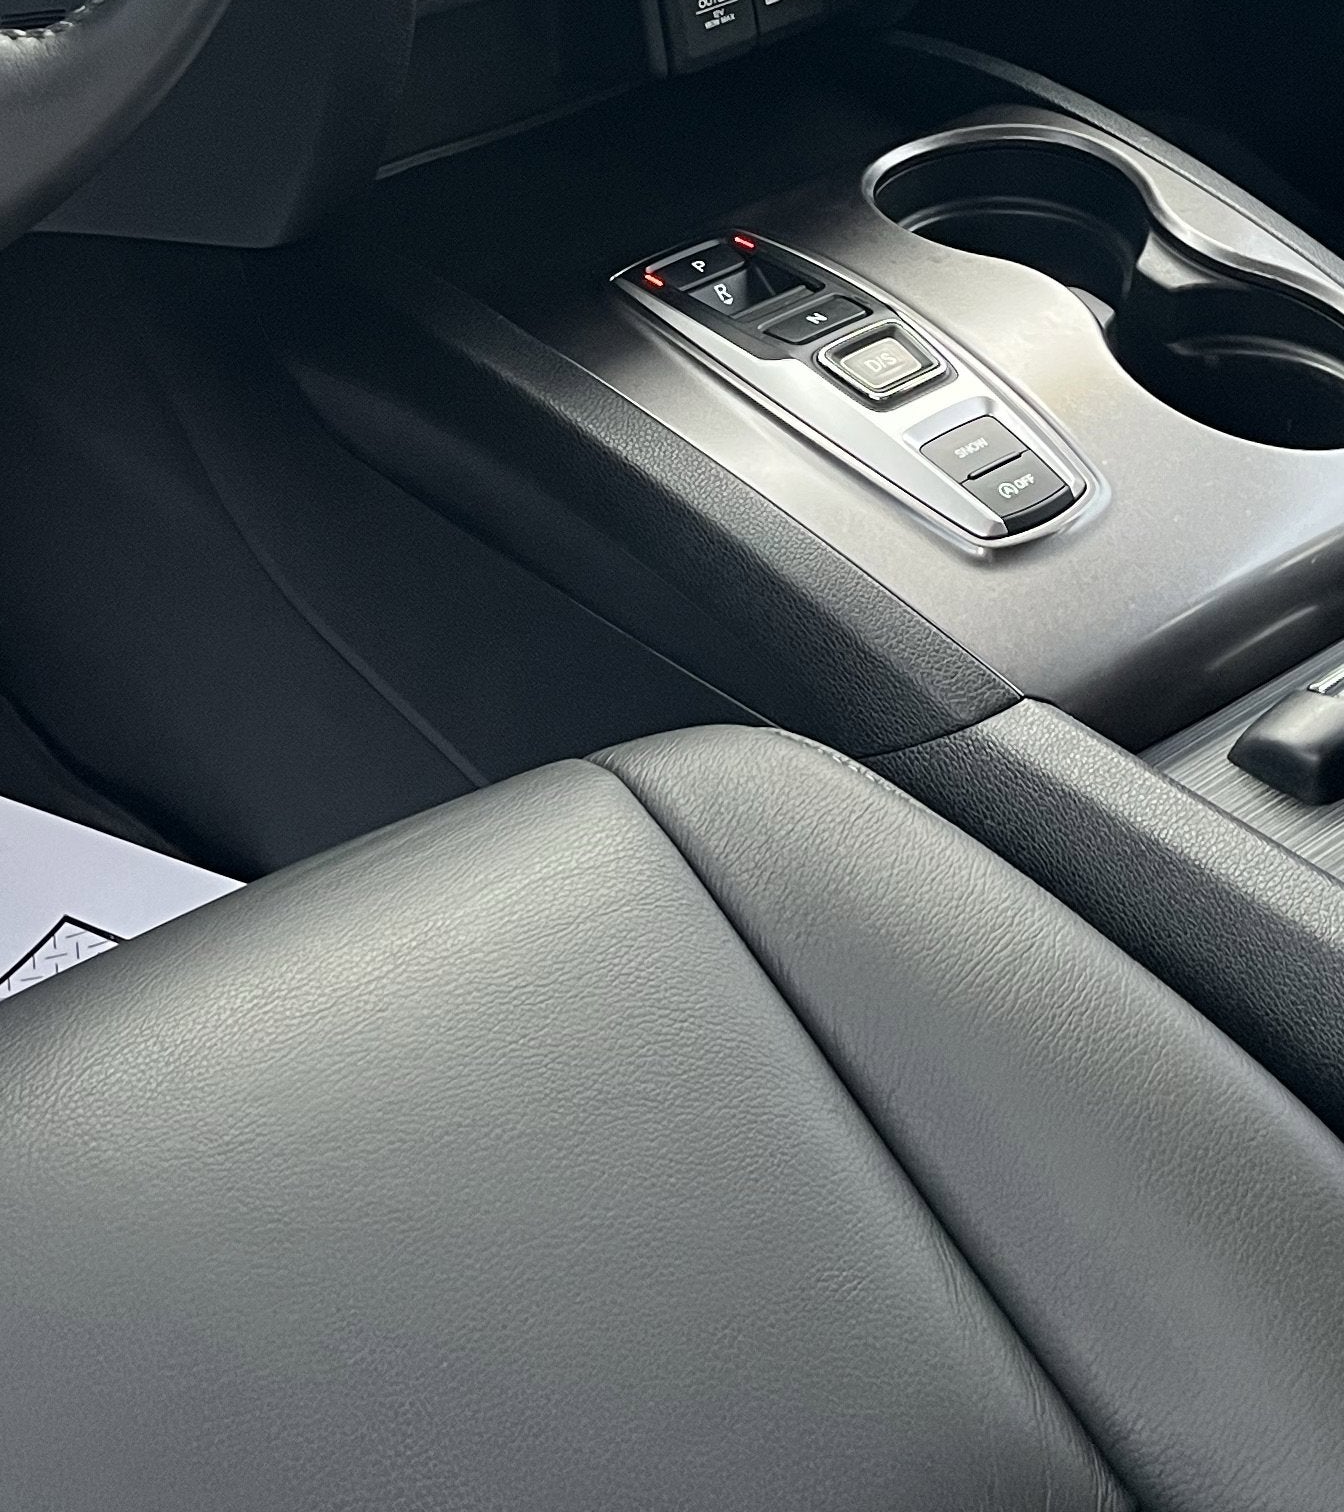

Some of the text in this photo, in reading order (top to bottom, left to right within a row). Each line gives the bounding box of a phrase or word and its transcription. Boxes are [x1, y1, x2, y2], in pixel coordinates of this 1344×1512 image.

[691, 260, 707, 273] P
[713, 283, 734, 305] R
[806, 312, 828, 325] N
[864, 352, 898, 374] D/S
[954, 437, 989, 459] SNOW
[1013, 473, 1034, 490] OFF
